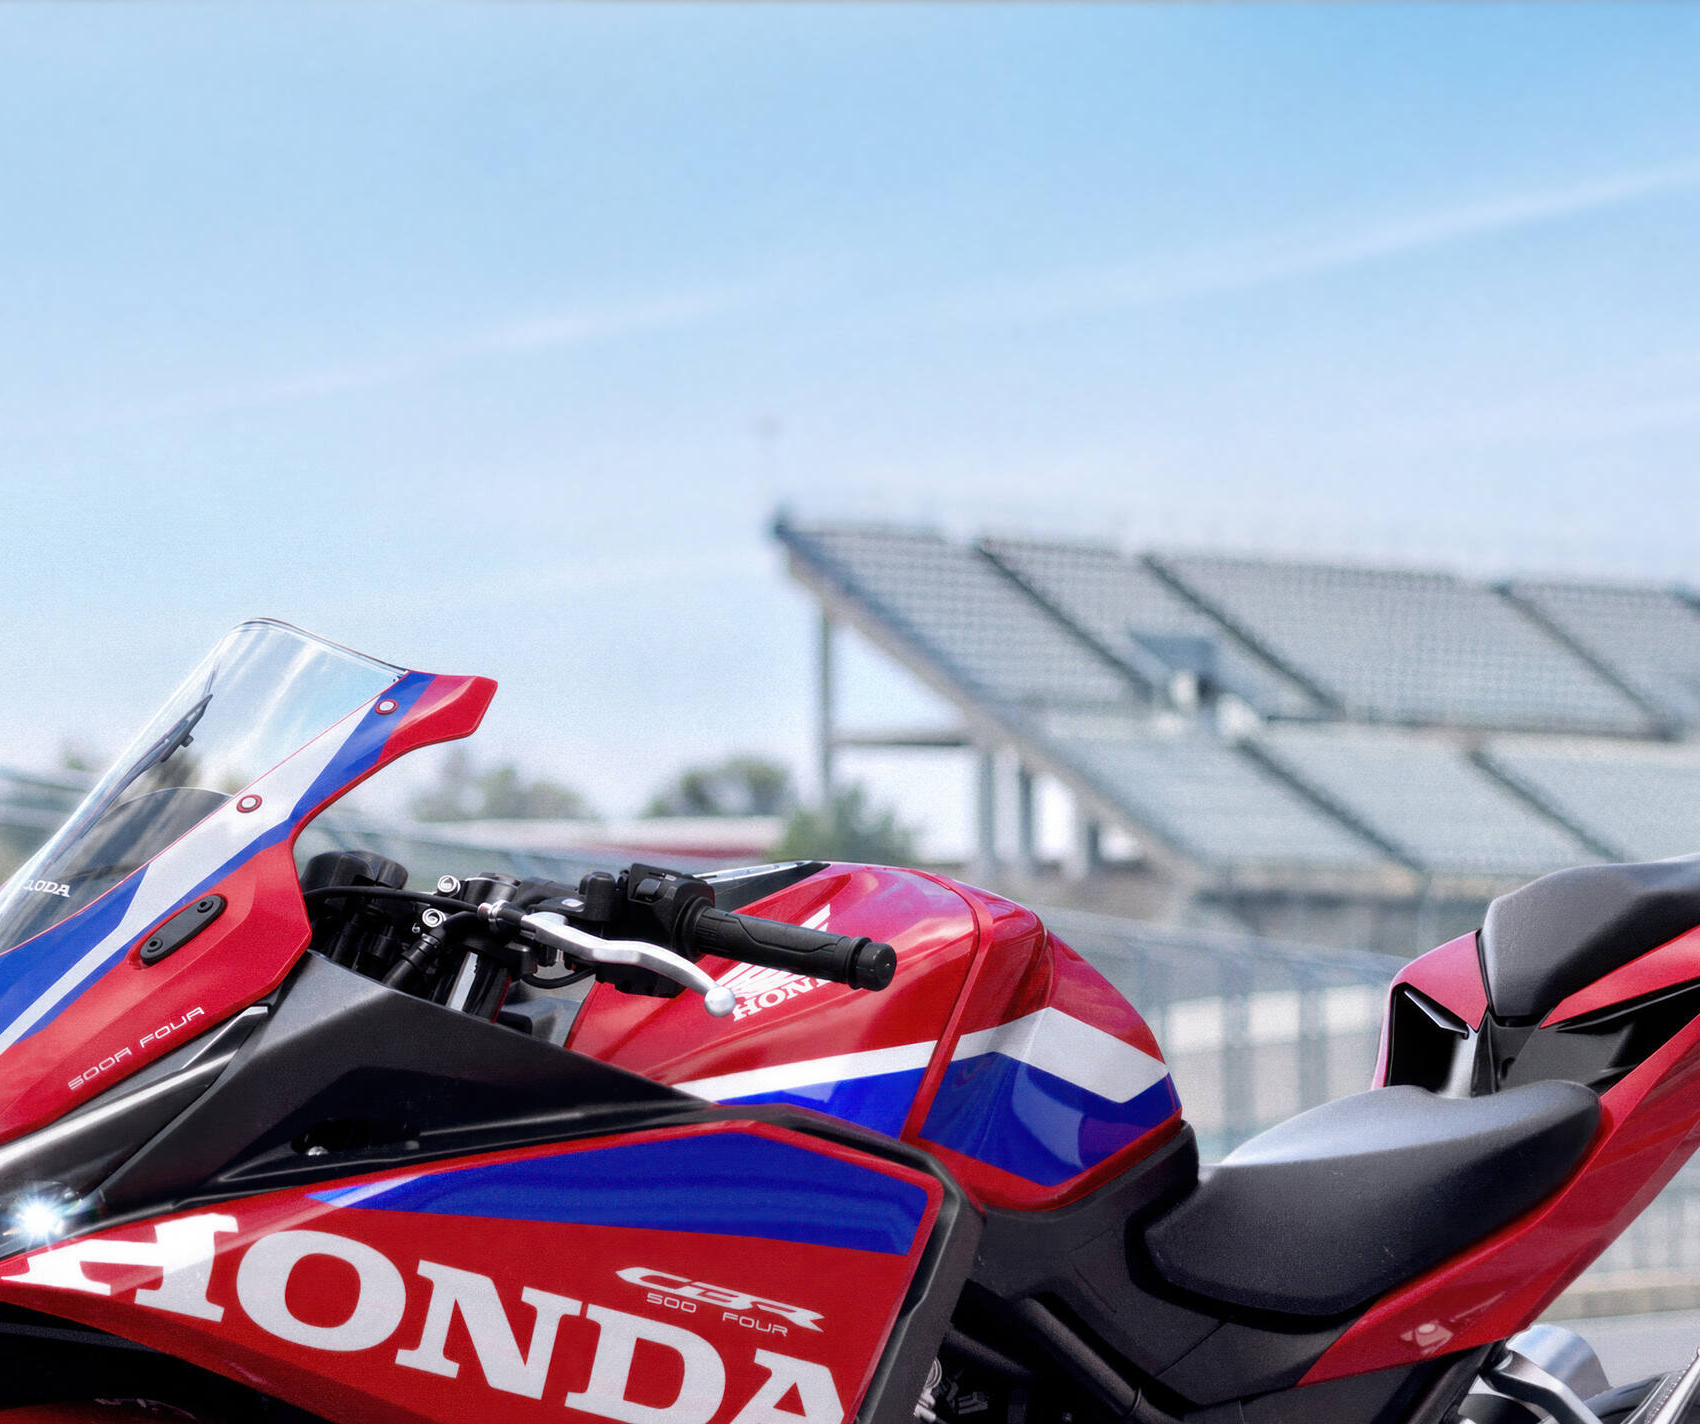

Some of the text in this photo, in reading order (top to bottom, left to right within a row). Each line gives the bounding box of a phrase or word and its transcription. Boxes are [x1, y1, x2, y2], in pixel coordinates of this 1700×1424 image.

[732, 976, 832, 1021] HON
[139, 1006, 205, 1048] FOUR
[615, 1266, 825, 1333] CBR
[646, 1292, 789, 1337] 500 FOUR
